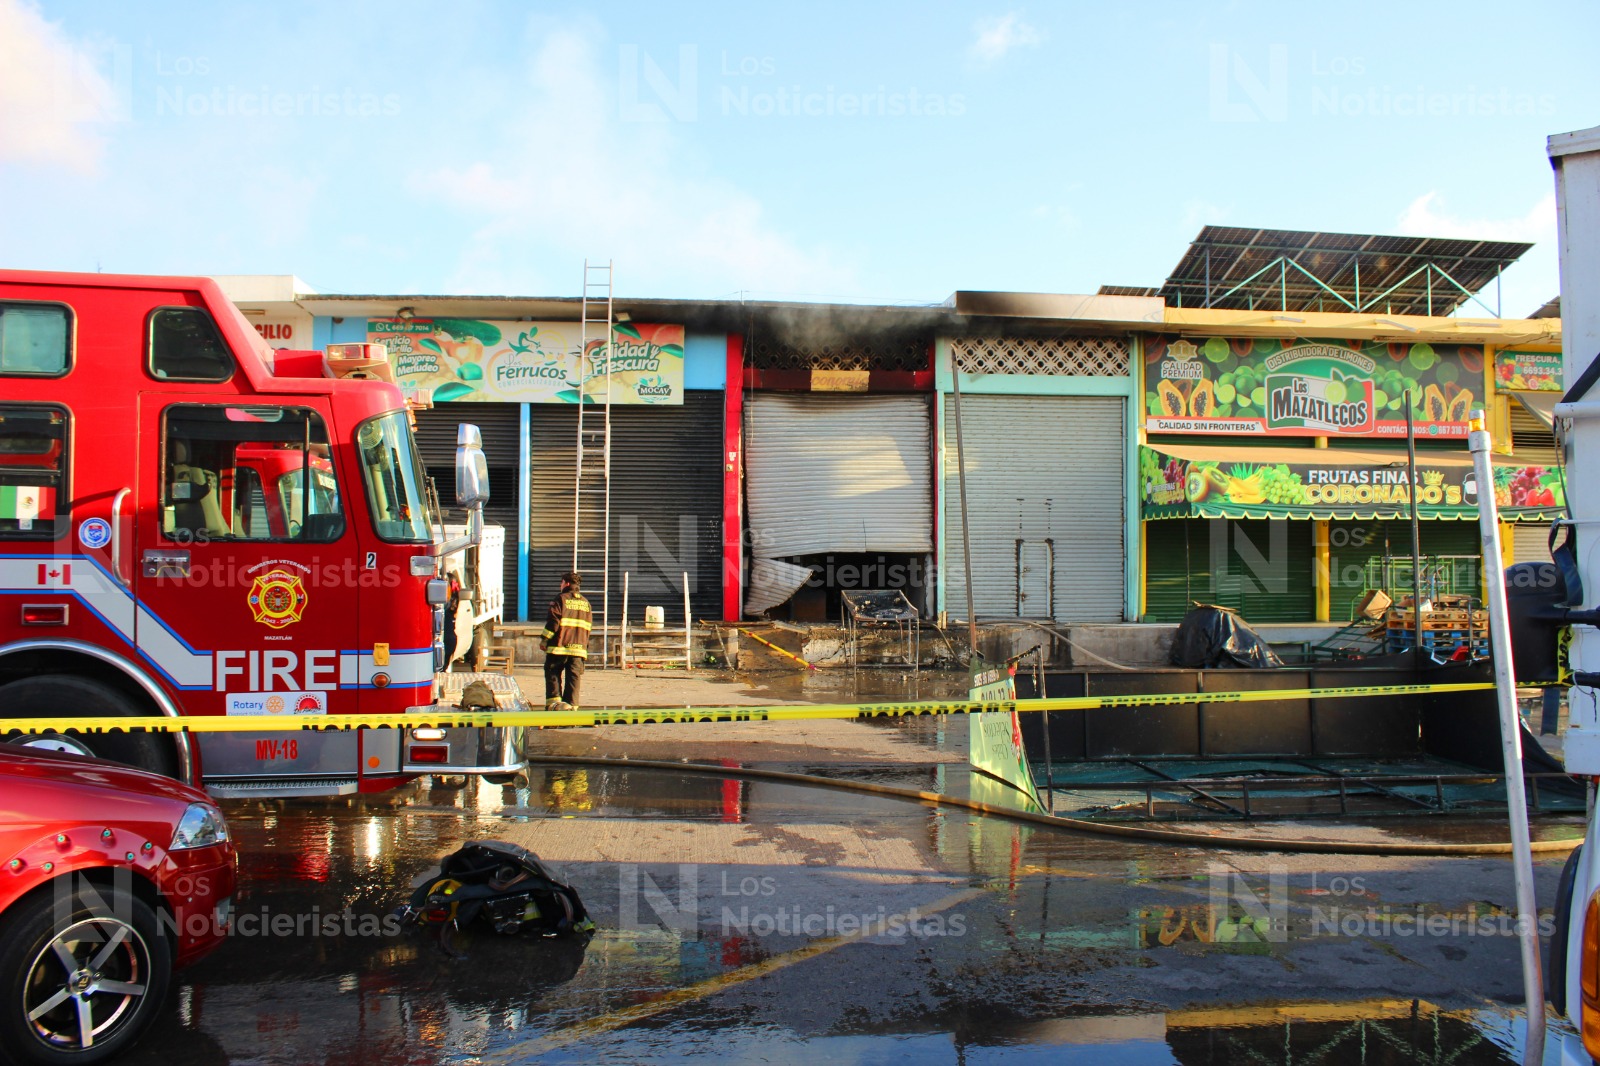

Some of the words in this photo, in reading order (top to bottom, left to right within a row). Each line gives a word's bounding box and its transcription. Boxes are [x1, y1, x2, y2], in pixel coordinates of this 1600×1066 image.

[375, 335, 411, 346] Servicio
[589, 341, 650, 363] Calidad
[650, 346, 660, 360] y
[1268, 347, 1328, 369] DISTRIBUIDORA
[1339, 349, 1373, 371] LIMONES
[399, 354, 437, 365] Mayoreo
[1162, 362, 1202, 370] CALIDAD
[1515, 354, 1561, 365] FRESCURA,
[397, 362, 439, 375] Menudeo
[496, 366, 568, 381] Ferrucos
[593, 359, 660, 375] Frescura
[1162, 370, 1202, 378] PREMIUM
[1294, 378, 1307, 393] Los
[1273, 388, 1367, 426] MAZATLECOS
[1193, 422, 1208, 430] SIN
[1377, 424, 1429, 434] CONTÁCTNOS:
[1308, 470, 1369, 484] FRUTAS
[247, 559, 278, 574] BOMBEROS
[279, 559, 311, 574] VETERANOS
[367, 553, 376, 568] 2
[216, 649, 337, 692] FIRE
[233, 701, 264, 711] Rotary
[255, 740, 298, 760] MV-18
